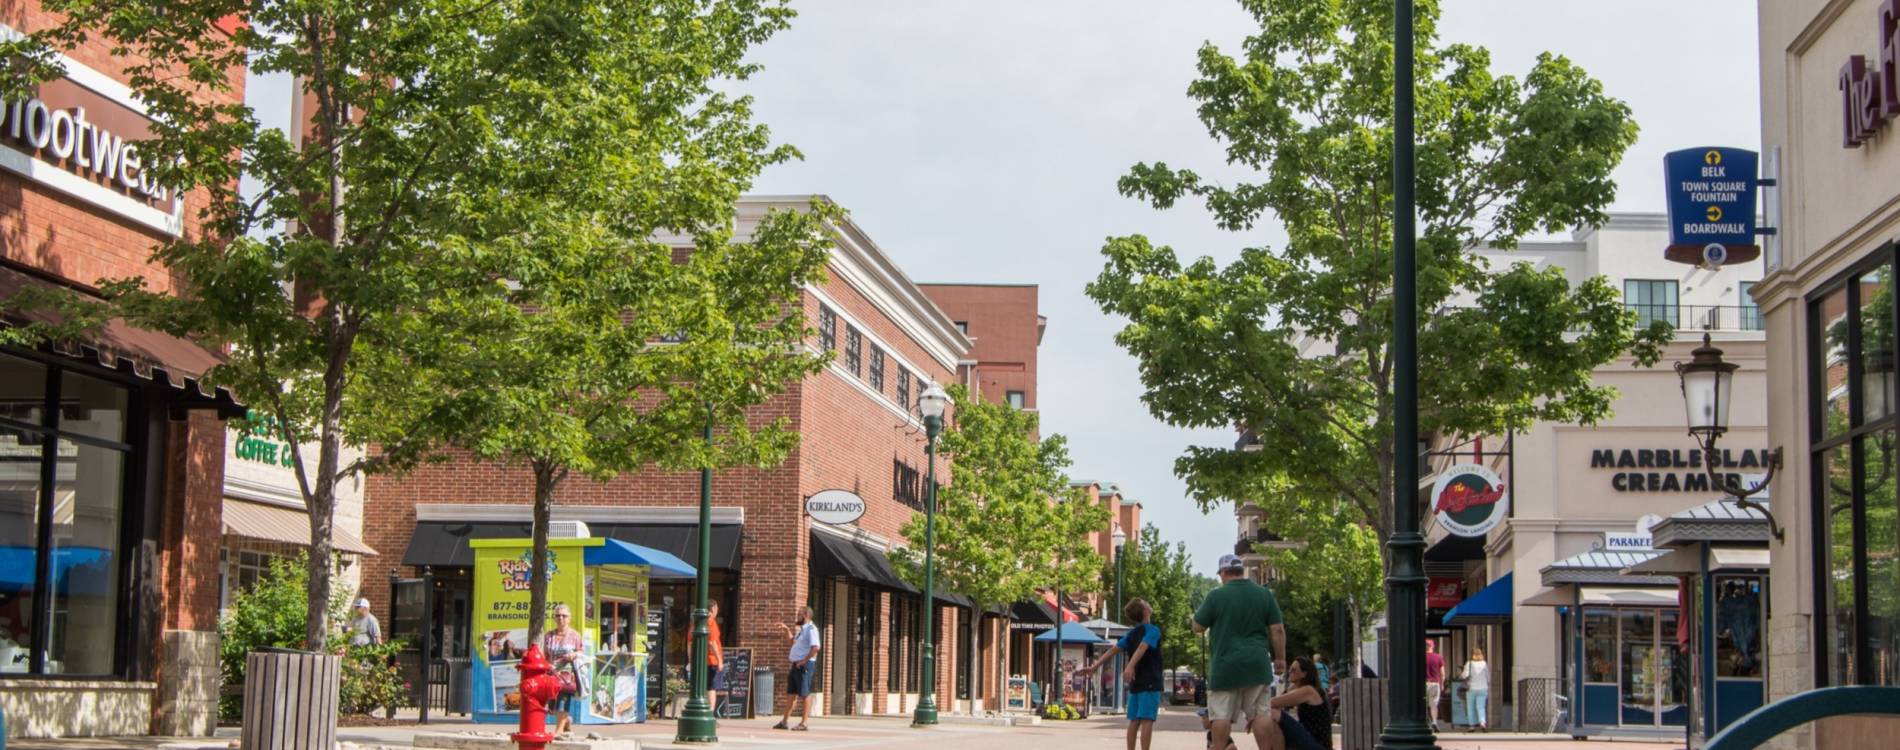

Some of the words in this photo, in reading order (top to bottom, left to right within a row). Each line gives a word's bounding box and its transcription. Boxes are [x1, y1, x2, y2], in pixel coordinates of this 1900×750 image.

[1839, 55, 1880, 148] The
[1702, 166, 1725, 177] BELK
[1682, 182, 1709, 192] TOWN
[1712, 182, 1746, 192] SQUARE
[1691, 192, 1737, 202] FOUNTAIN
[1684, 223, 1745, 234] BOARDWALK
[1591, 449, 1702, 468] MARBLE
[809, 501, 863, 513] KIRKLAND'S
[1609, 537, 1652, 547] PARAKEE
